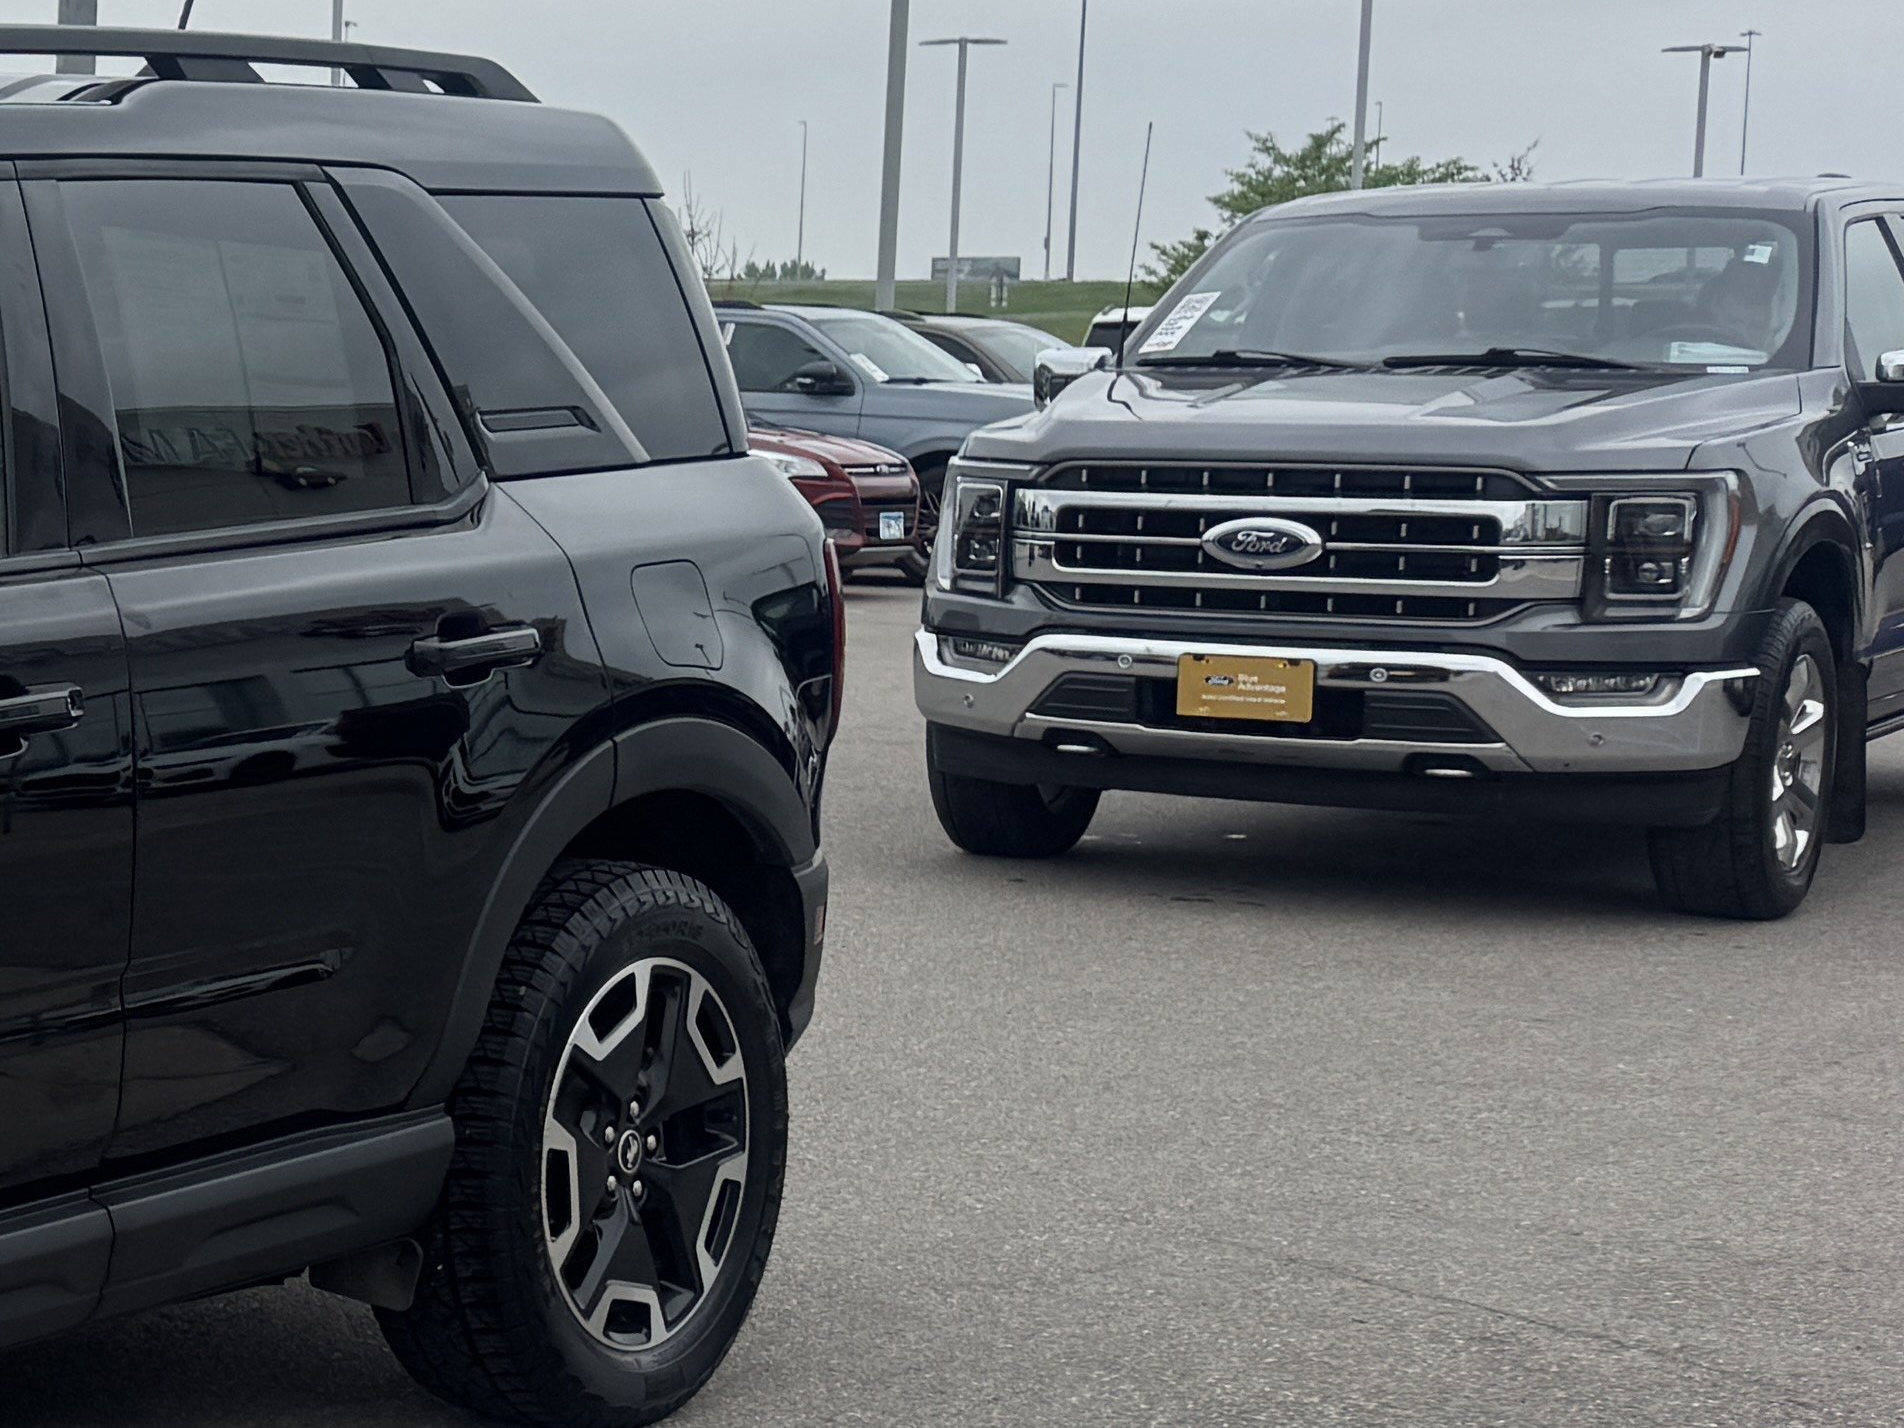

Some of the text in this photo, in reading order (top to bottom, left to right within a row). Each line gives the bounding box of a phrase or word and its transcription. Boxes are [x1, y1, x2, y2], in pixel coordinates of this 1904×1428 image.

[1231, 530, 1288, 554] Ford
[1237, 673, 1259, 684] Blue
[1237, 683, 1287, 694] Advantage
